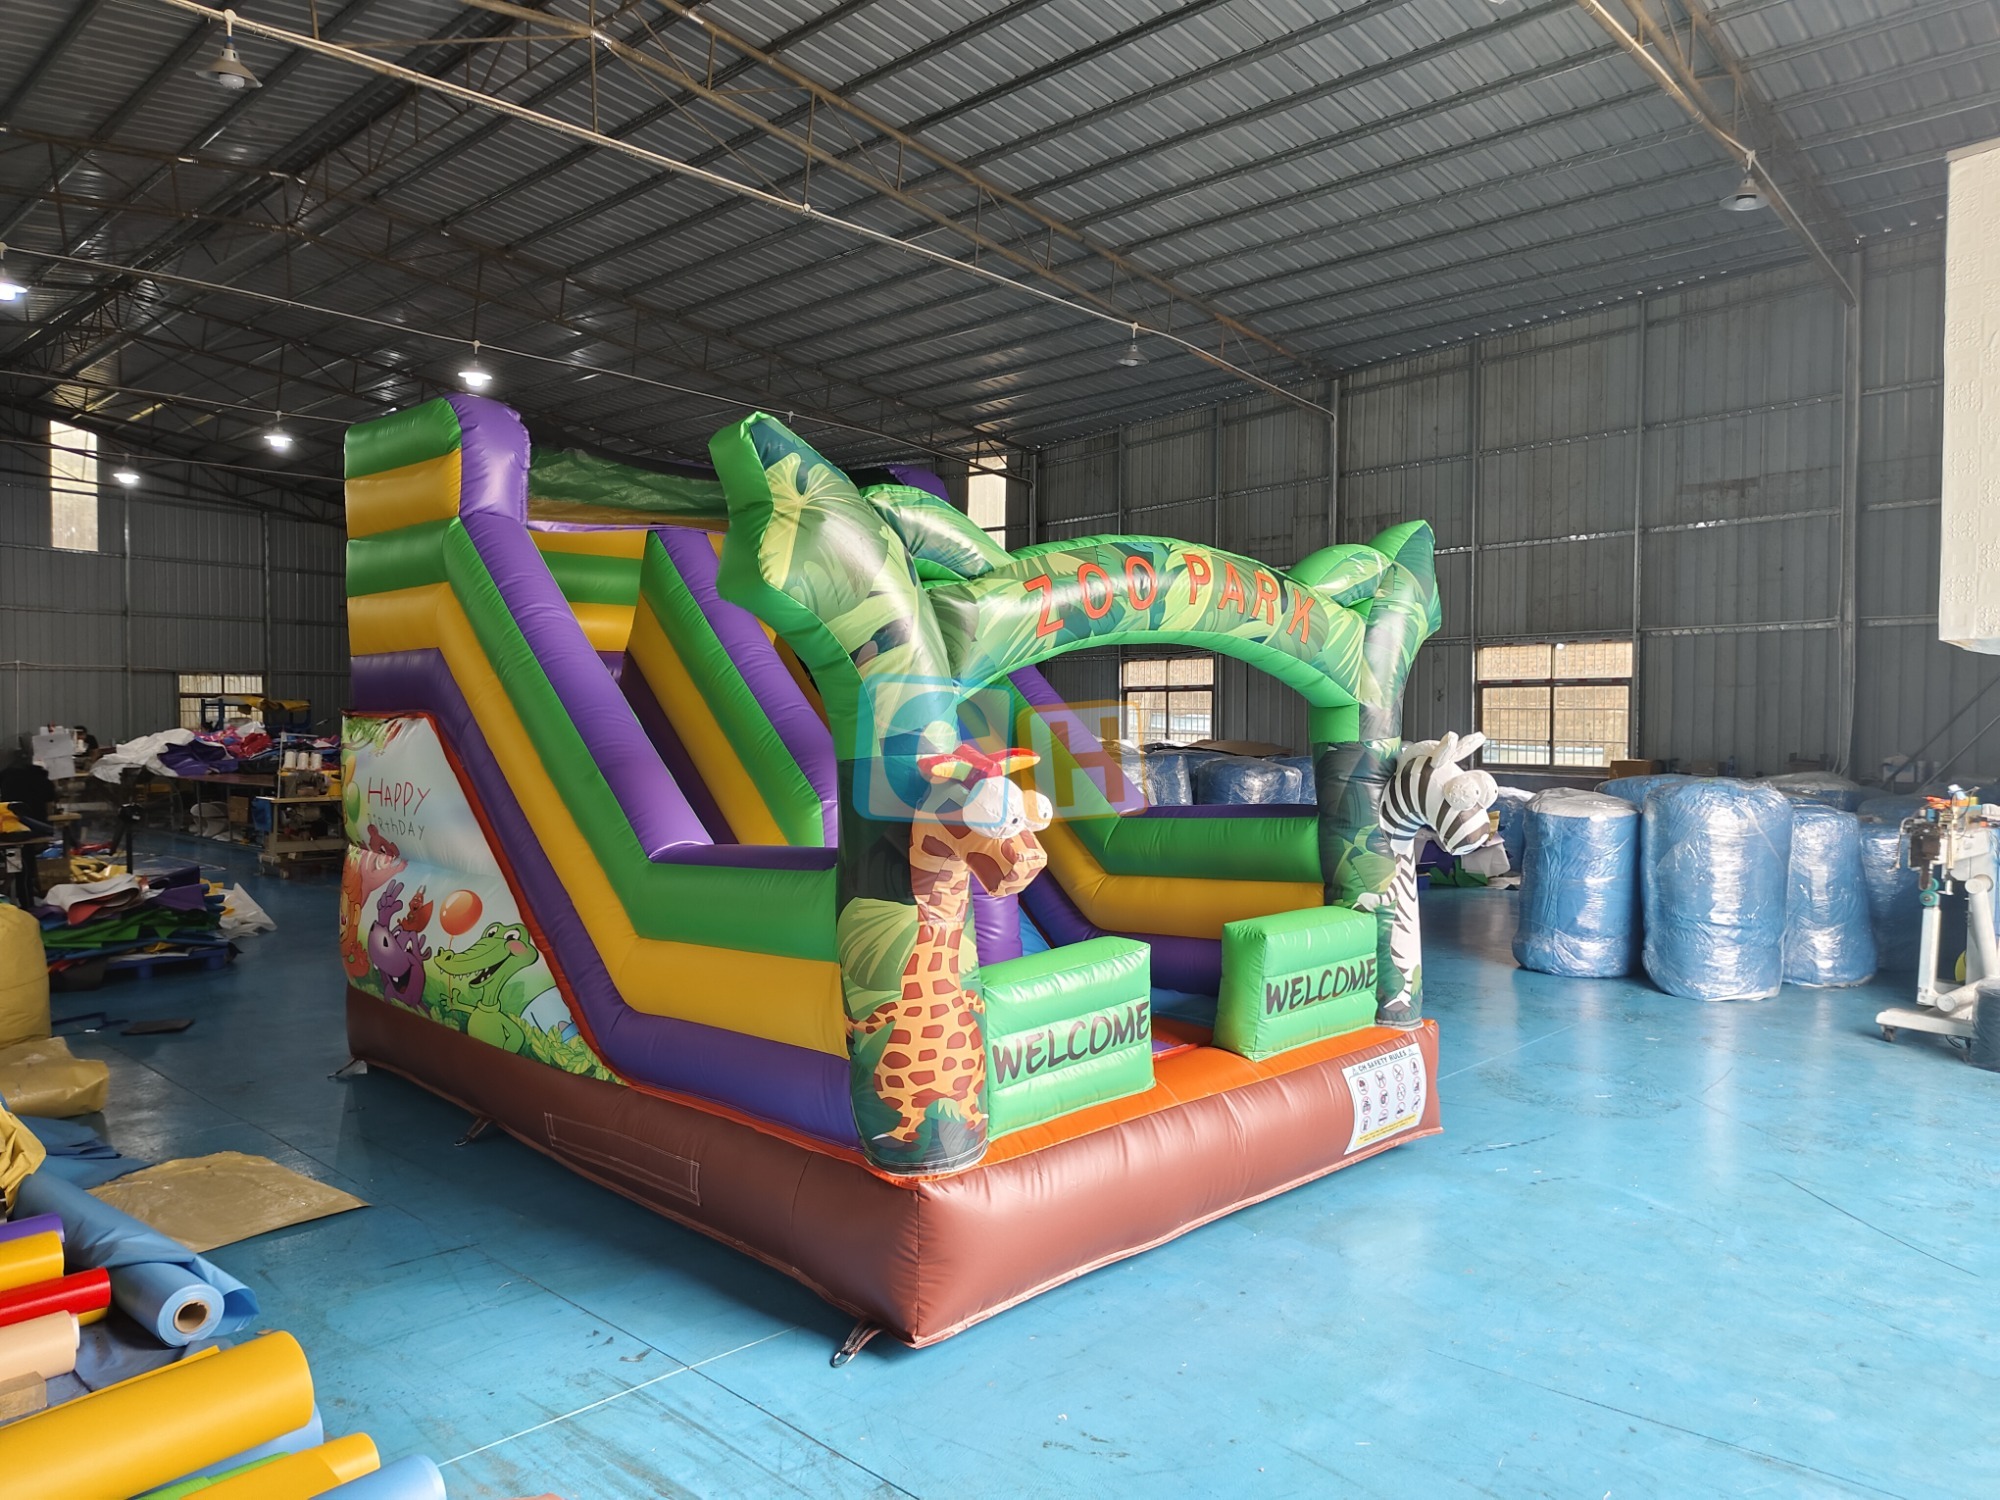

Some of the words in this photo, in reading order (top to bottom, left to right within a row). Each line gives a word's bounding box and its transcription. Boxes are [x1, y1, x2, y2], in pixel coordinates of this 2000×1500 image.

[1023, 555, 1158, 639] ZOO
[1182, 553, 1316, 645] PARK
[368, 776, 431, 817] HAPPY
[1266, 957, 1378, 1015] WELCOME
[992, 1000, 1150, 1084] WELCOME
[1368, 1057, 1388, 1068] SAFETY
[1389, 1050, 1407, 1062] RULES
